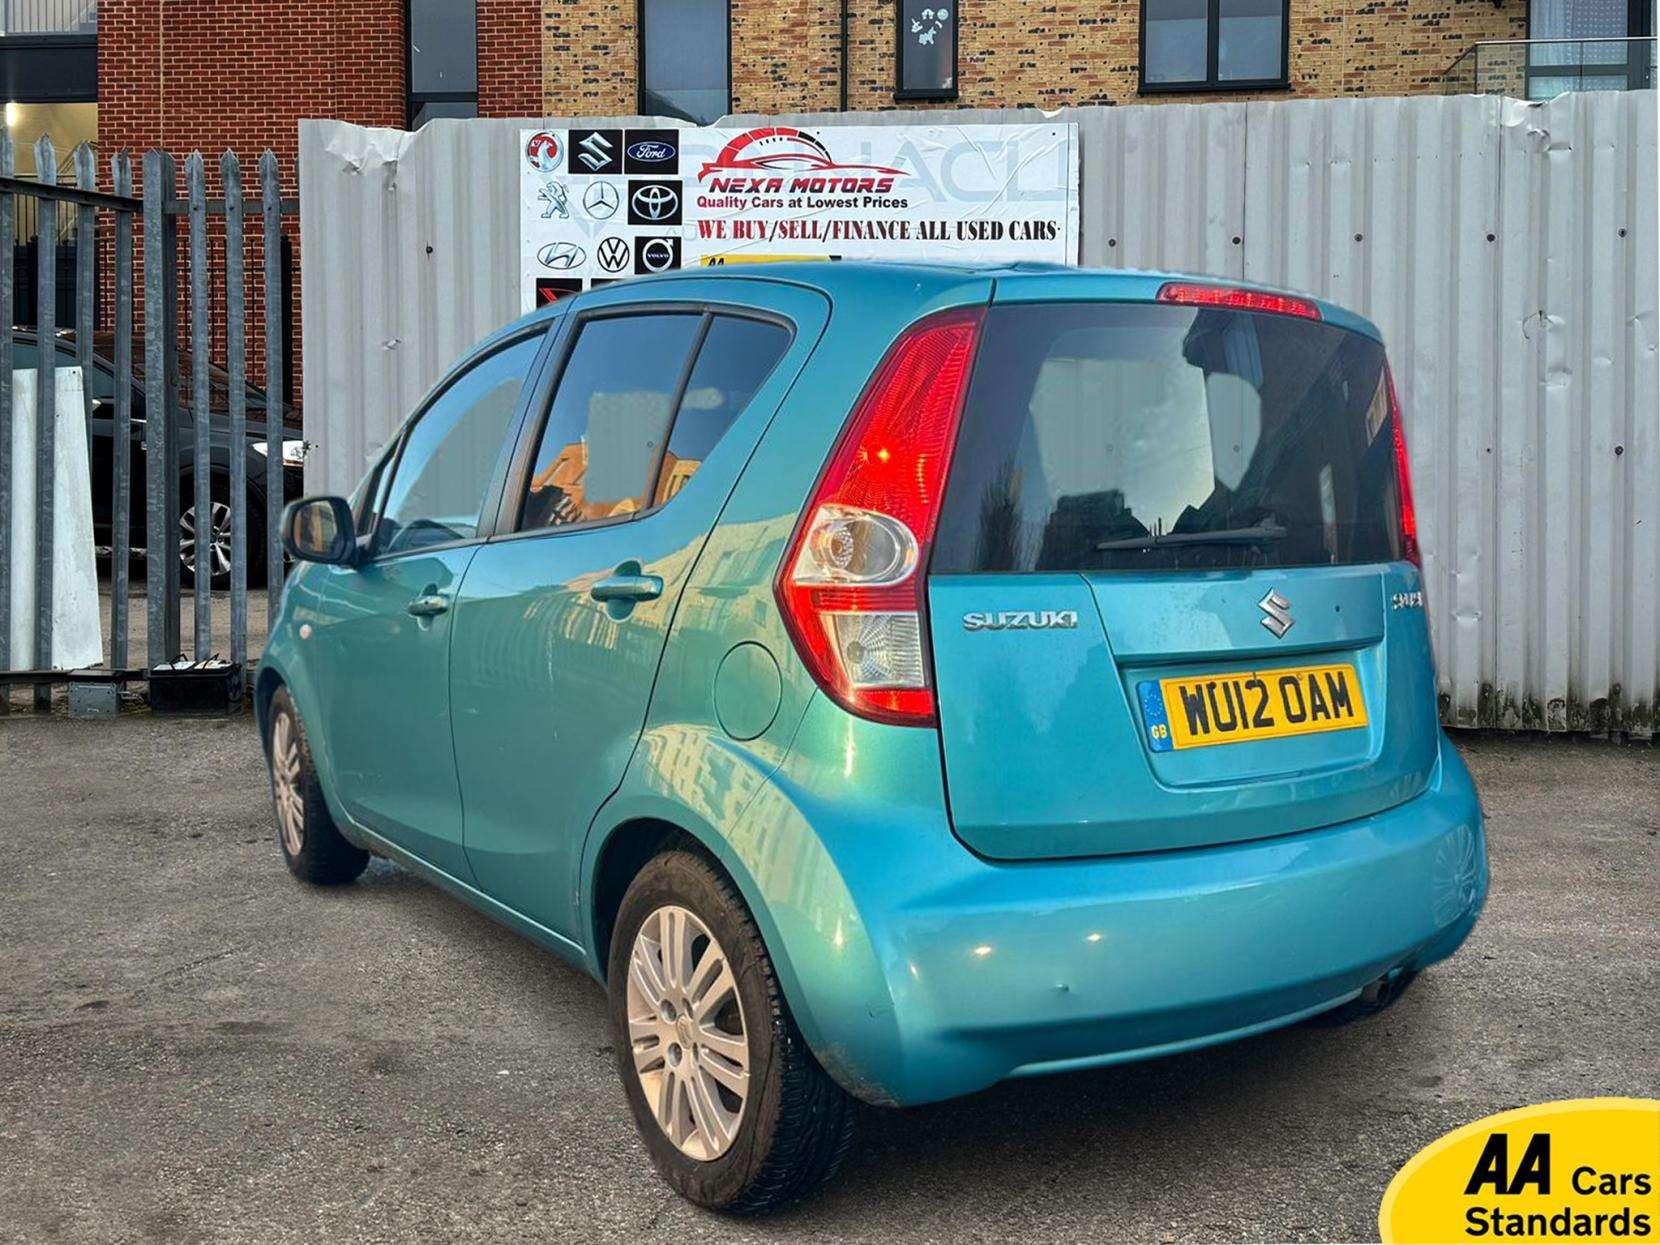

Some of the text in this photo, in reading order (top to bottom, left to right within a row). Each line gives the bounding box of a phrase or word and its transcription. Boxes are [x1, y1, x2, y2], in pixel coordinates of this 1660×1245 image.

[636, 144, 666, 158] Ford
[709, 178, 895, 194] NEXA MOTORS
[697, 196, 908, 211] Quality Cars at Lowest Prices
[697, 220, 727, 240] WE
[916, 220, 951, 240] ALL
[956, 220, 1004, 241] USED
[1008, 220, 1057, 241] CARS
[963, 610, 1078, 631] SUZUKI
[1179, 671, 1354, 736] WU12 OAM
[1150, 724, 1168, 740] GB
